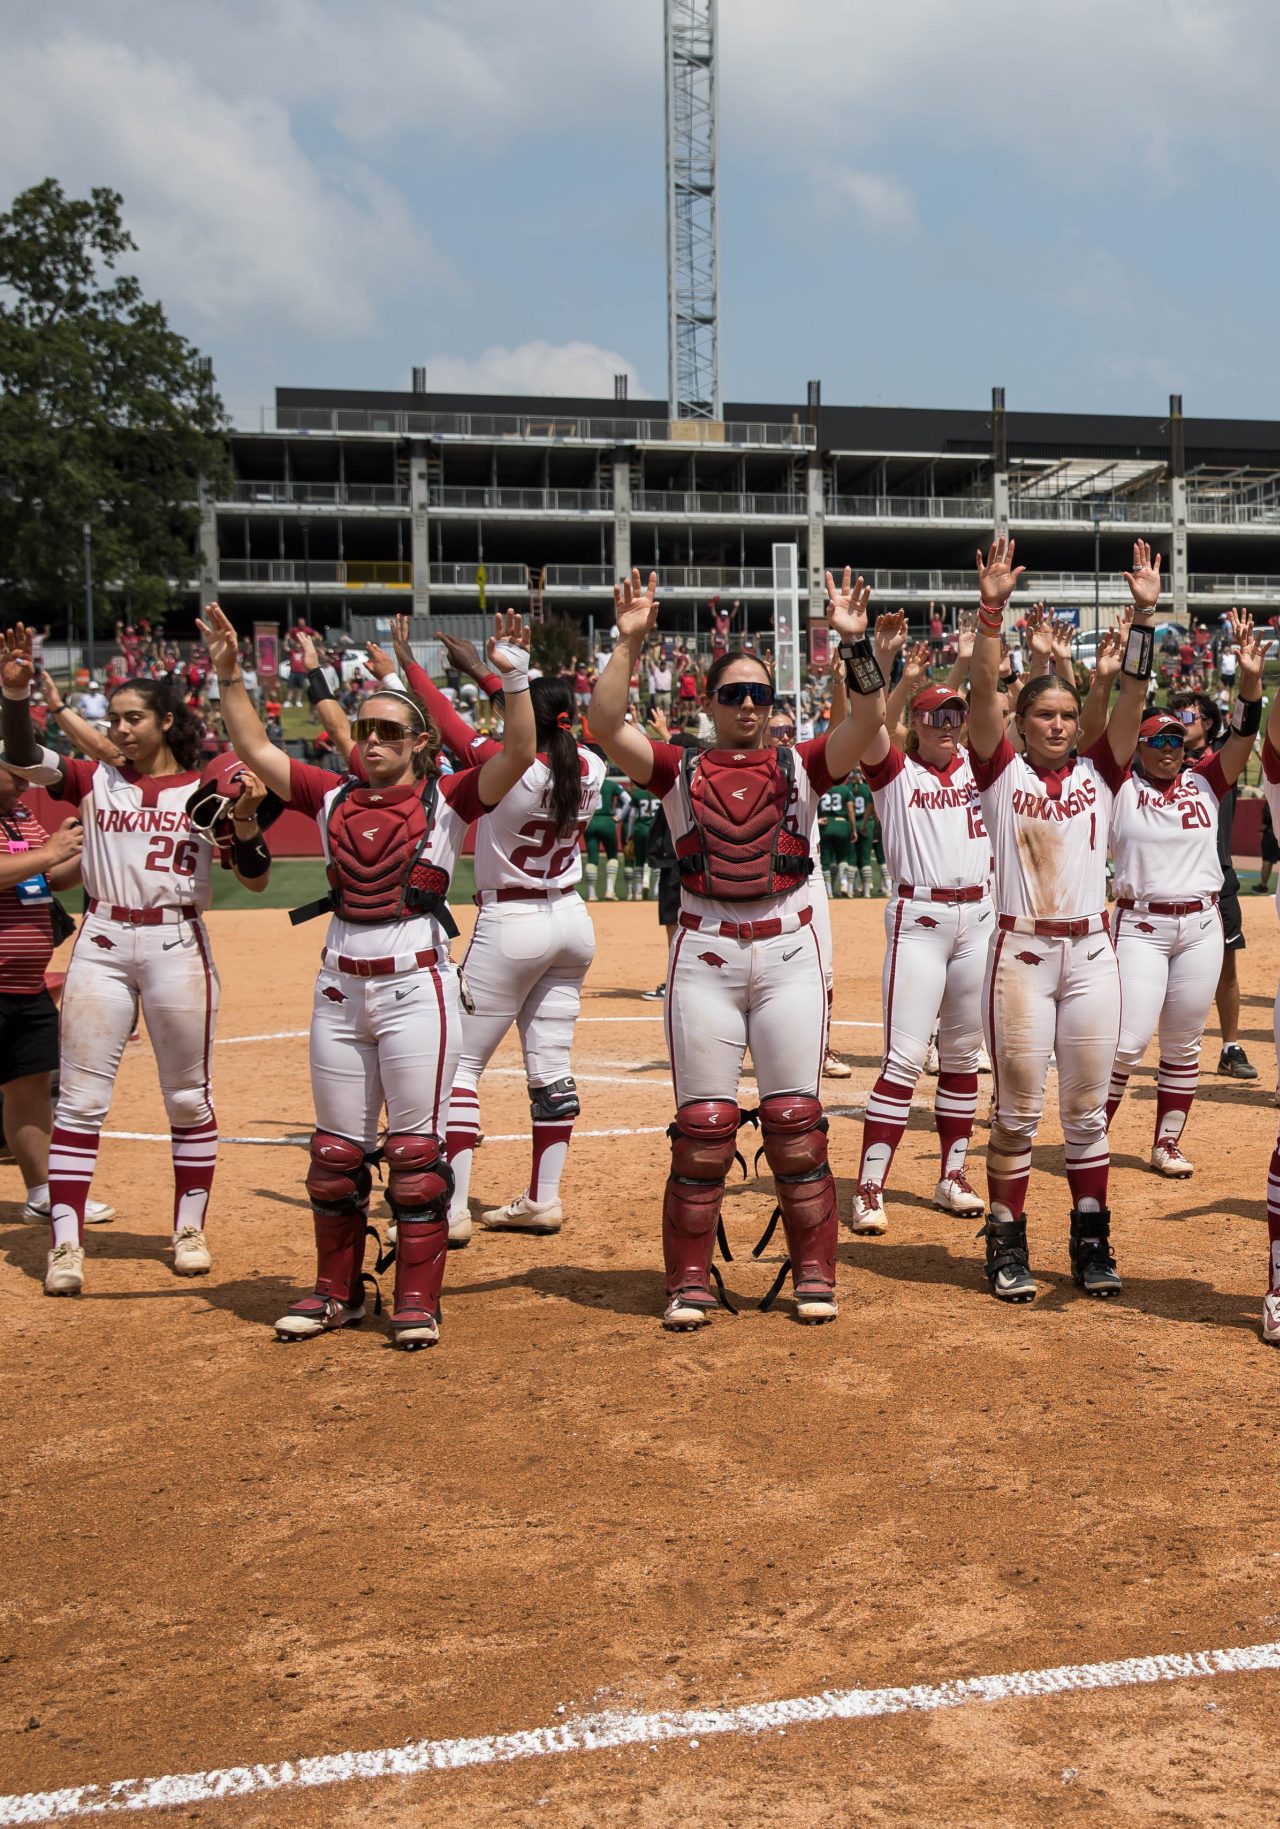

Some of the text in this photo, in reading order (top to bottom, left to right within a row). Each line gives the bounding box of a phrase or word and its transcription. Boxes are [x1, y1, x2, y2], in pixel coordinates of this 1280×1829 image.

[820, 793, 842, 811] 23
[1012, 778, 1096, 821] ARKANSAS
[1177, 801, 1211, 830] 20
[966, 805, 988, 839] 12
[1090, 813, 1096, 850] 1
[145, 836, 199, 876] 26
[509, 820, 589, 879] 22
